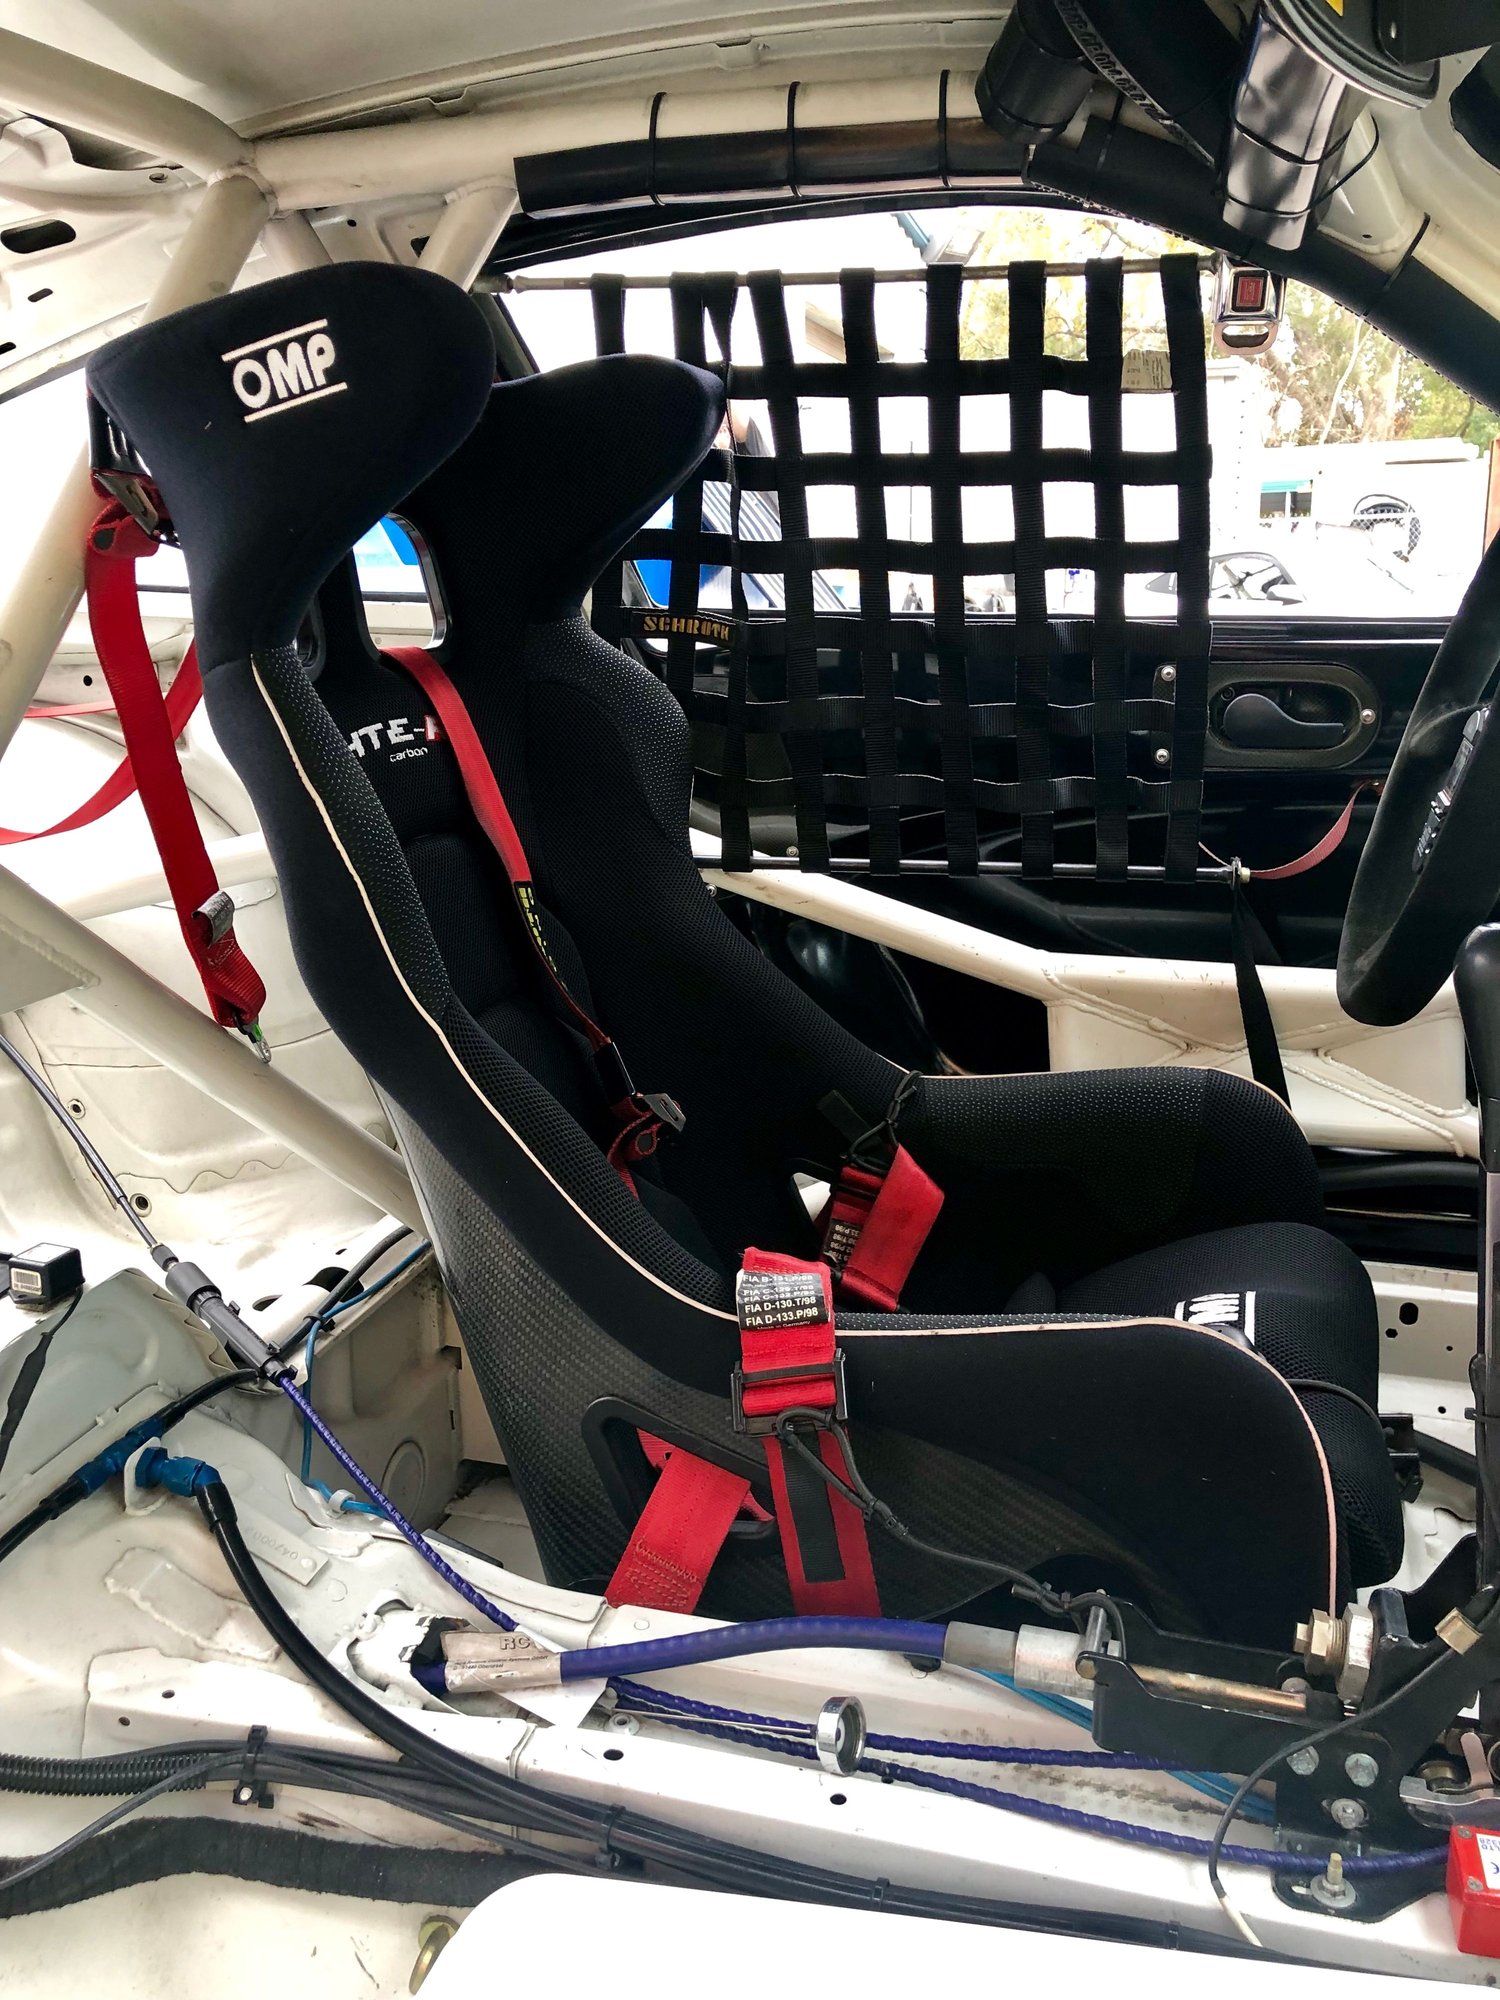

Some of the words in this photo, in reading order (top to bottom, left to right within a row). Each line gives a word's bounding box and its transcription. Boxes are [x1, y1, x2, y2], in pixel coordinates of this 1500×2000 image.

[233, 333, 336, 408] OMP
[643, 616, 730, 640] SCHROTH
[390, 747, 429, 763] carbon
[743, 1274, 760, 1282] FIA
[744, 1295, 761, 1303] FIA
[744, 1303, 763, 1314] FIA
[763, 1296, 817, 1311] D-130.T/98
[745, 1316, 764, 1327] FIA
[764, 1307, 819, 1324] D-133.P/98
